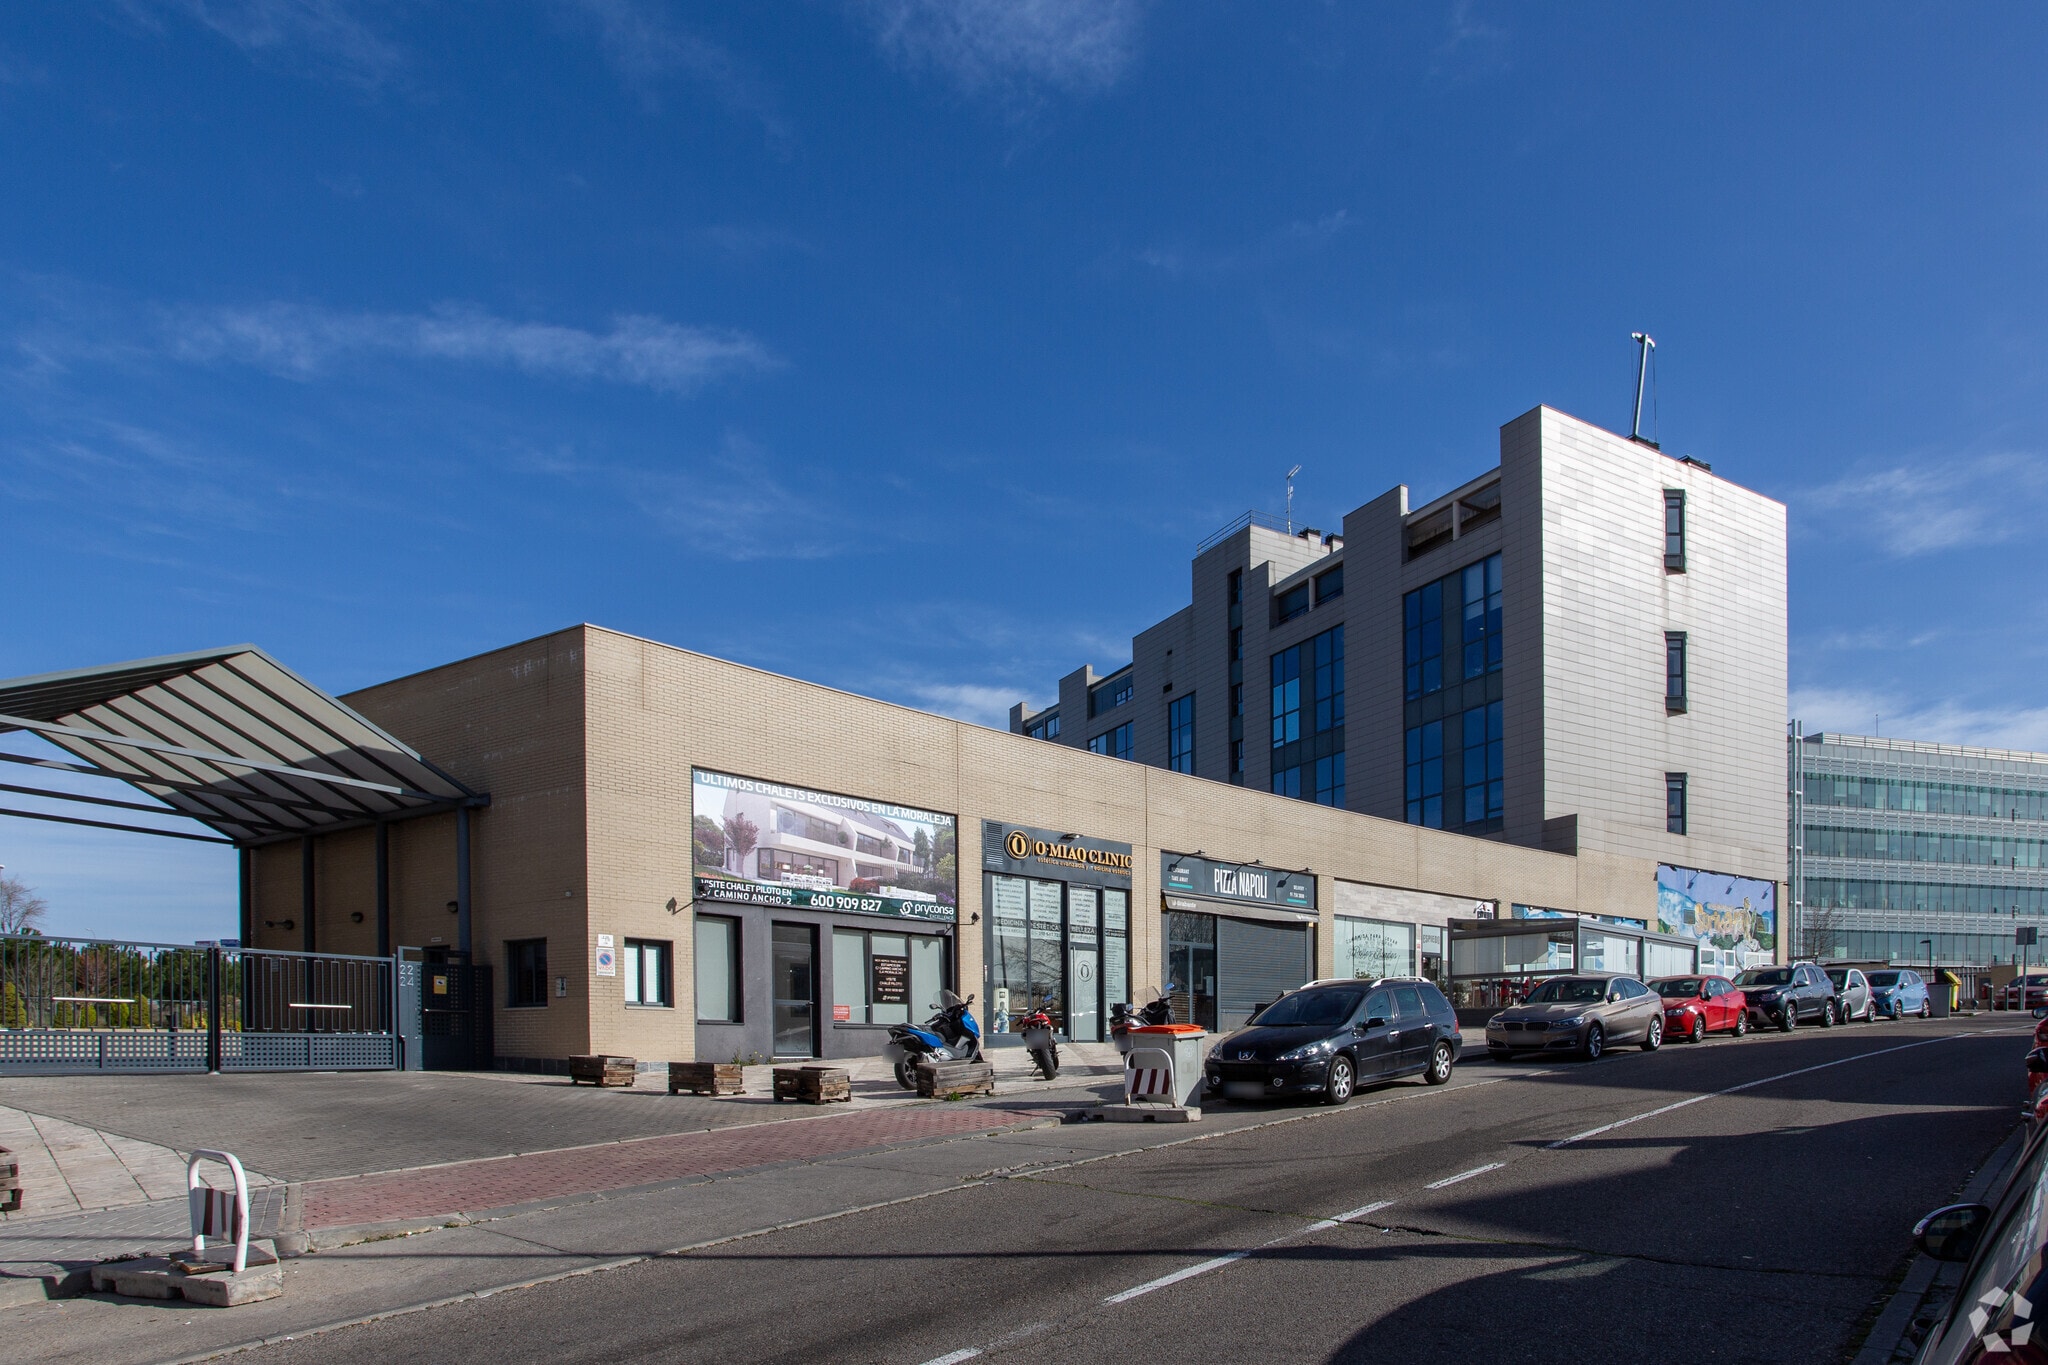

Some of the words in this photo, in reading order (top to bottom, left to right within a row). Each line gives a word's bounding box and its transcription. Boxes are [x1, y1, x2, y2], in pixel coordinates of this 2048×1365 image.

[755, 783, 806, 800] CHALETS
[807, 790, 871, 812] EXCLUSIVOS
[871, 803, 886, 814] EN
[886, 807, 900, 817] LA
[900, 807, 952, 826] MORALEJA
[1088, 849, 1133, 868] CLINIC
[726, 881, 755, 892] CHALET
[755, 885, 781, 895] PILOTO
[782, 888, 792, 896] EN
[1239, 871, 1268, 899] NAPOLI
[714, 889, 750, 901] CAMINO
[786, 897, 792, 905] 2
[810, 893, 835, 908] 600
[836, 896, 859, 910] 909
[860, 900, 883, 912] 827
[914, 903, 954, 915] pryconsa
[995, 918, 1025, 927] MEDICINA
[1071, 925, 1095, 934] BELLEZA
[399, 964, 414, 975] 22
[399, 976, 414, 987] 24
